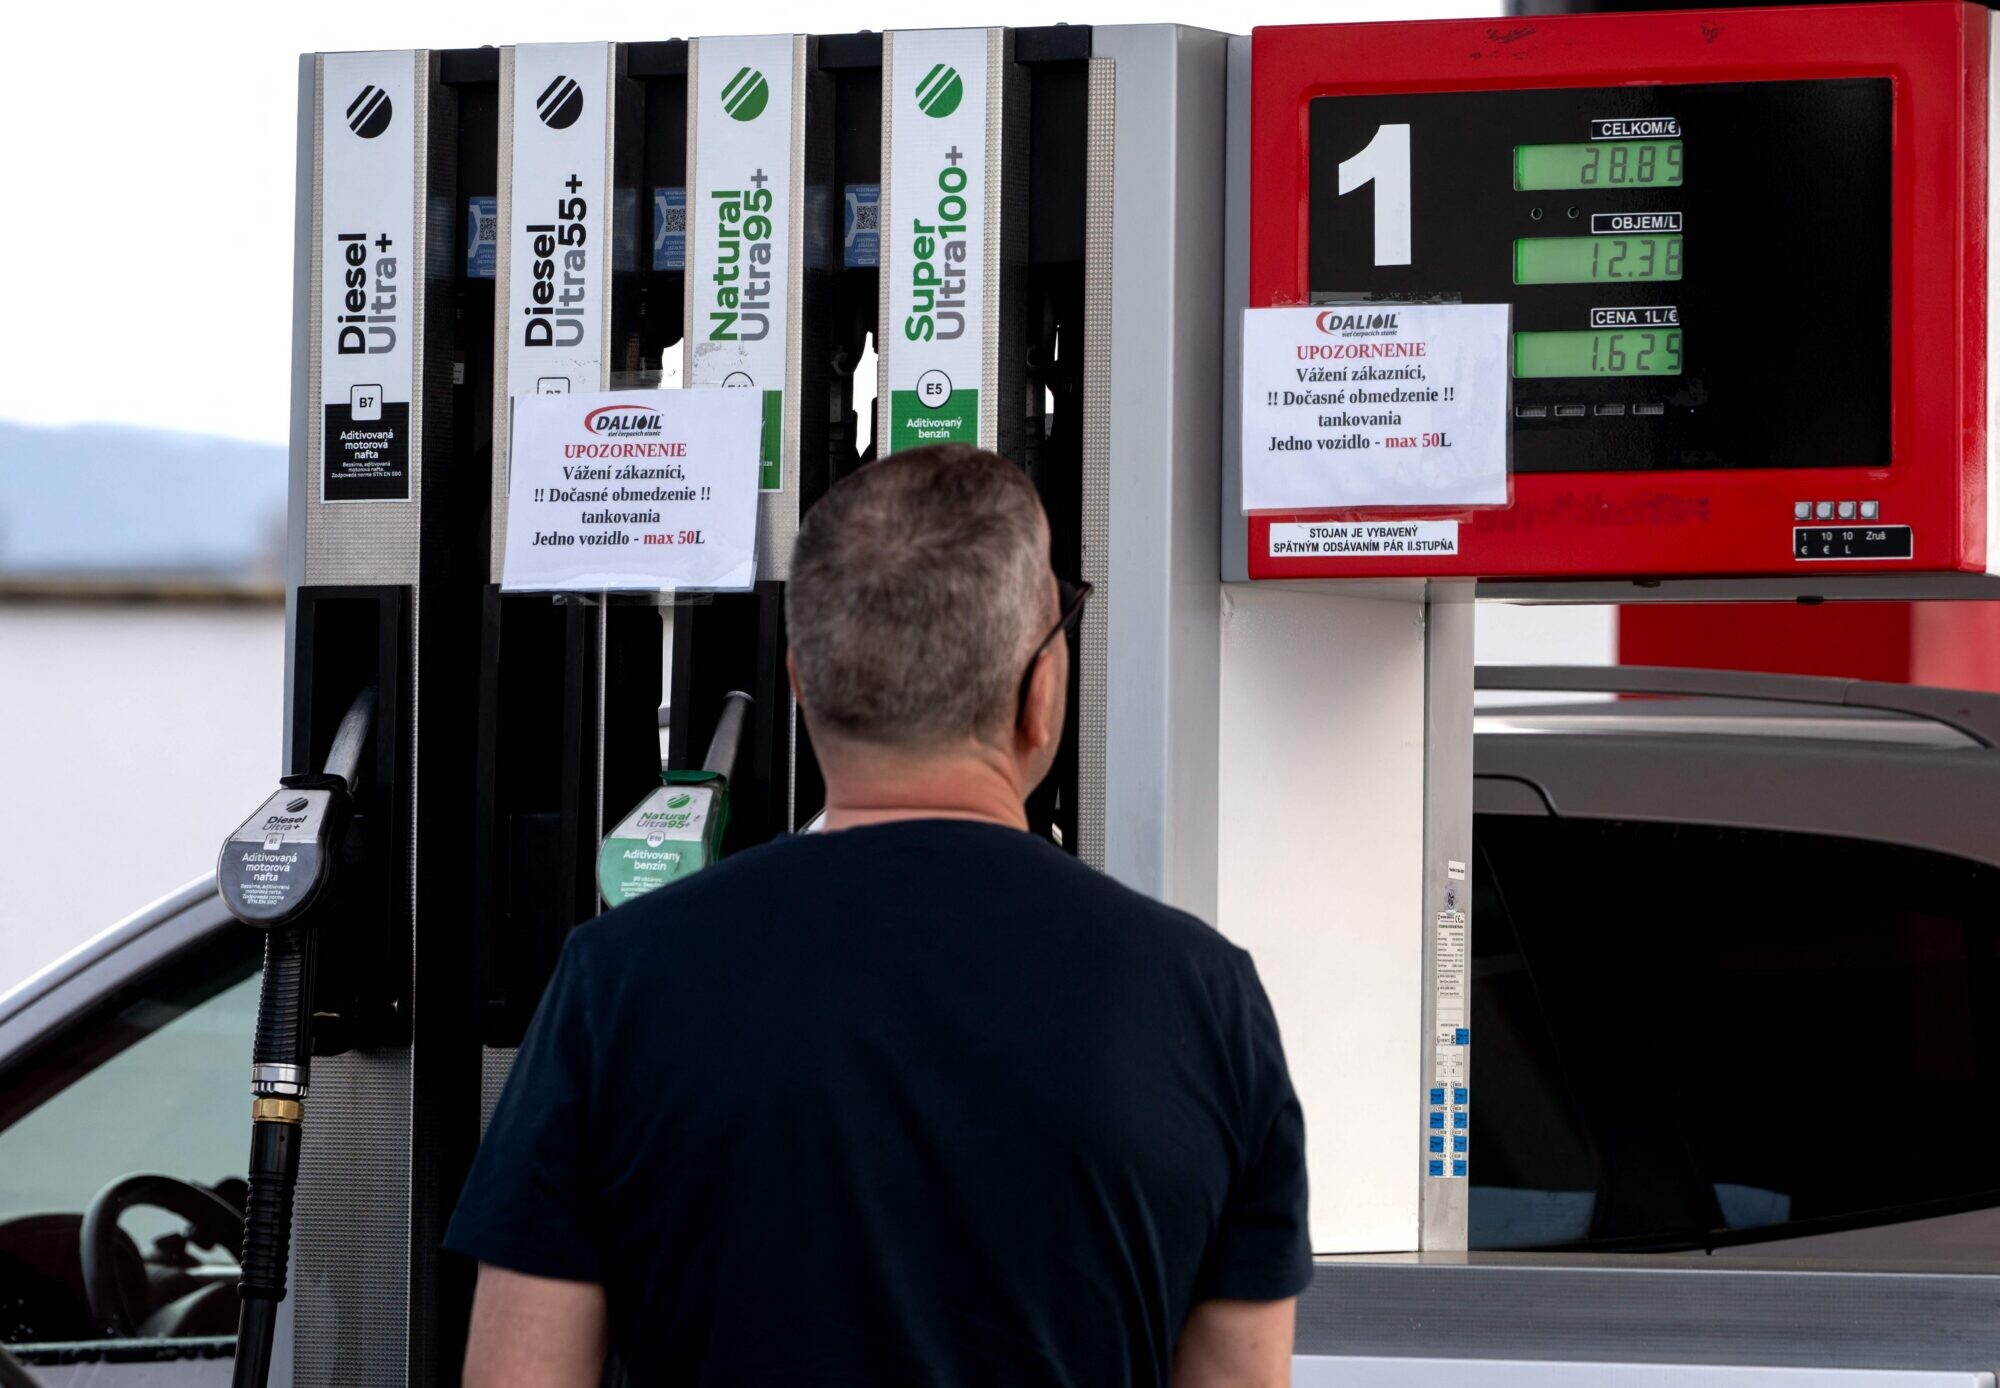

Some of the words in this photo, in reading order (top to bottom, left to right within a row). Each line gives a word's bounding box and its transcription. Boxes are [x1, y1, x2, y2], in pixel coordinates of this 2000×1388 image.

[1602, 121, 1677, 136] CELKOM/€
[1339, 123, 1411, 266] 1
[1611, 216, 1678, 230] OBJEM/L
[936, 145, 967, 340] Ultra100+
[555, 174, 587, 347] Ultra55+
[740, 168, 773, 341] Ultra95+
[709, 190, 741, 341] Natural
[525, 225, 556, 347] Diesel
[905, 218, 942, 342] Super
[338, 233, 366, 354] Diesel
[368, 233, 397, 354] Ultra+
[1596, 311, 1637, 324] CENA
[1296, 342, 1426, 360] UPOZORNENIE
[1296, 366, 1347, 383] Vážení
[1351, 364, 1426, 382] zákazníci,
[926, 383, 942, 395] E5
[359, 397, 374, 408] B7
[1267, 391, 1278, 406] !!
[1282, 389, 1345, 406] Dočasné
[1349, 387, 1438, 404] obmedzenie
[1443, 387, 1455, 401] !!
[906, 416, 962, 429] Aditivovaný
[1318, 411, 1402, 428] tankovania
[340, 429, 394, 440] Aditivovaná
[918, 428, 950, 438] benzín
[345, 439, 388, 449] motorová
[1268, 435, 1312, 452] Jedno
[1316, 434, 1370, 450] vozidlo
[1385, 436, 1417, 448] max
[1422, 432, 1452, 447] 50L
[354, 450, 379, 459] nafta
[564, 443, 687, 459] UPOZORNENIE
[563, 465, 611, 480] Vážení
[615, 464, 685, 481] zákazníci,
[534, 488, 544, 502] !!
[549, 487, 608, 502] Dočasné
[612, 486, 696, 501] obmedzenie
[700, 486, 711, 501] !!
[581, 509, 660, 524] tankovania
[532, 531, 575, 547] Jedno
[579, 530, 629, 545] vozidlo
[643, 533, 674, 545] max
[678, 530, 705, 545] 50L
[1309, 528, 1348, 539] STOJAN
[1351, 527, 1362, 538] JE
[1367, 525, 1418, 538] VYBAVENÝ
[1802, 532, 1807, 541] 1
[1822, 531, 1832, 540] 10
[1842, 531, 1853, 540] 10
[1866, 531, 1886, 540] Zruš
[1273, 540, 1319, 553] SPÄTNÝM
[1323, 539, 1380, 552] ODSÁVANÍM
[1383, 538, 1404, 551] PÁR
[1407, 538, 1454, 551] II.STUPŇA
[1845, 545, 1851, 554] L
[267, 815, 307, 824] Diesel
[641, 812, 691, 820] Natural
[262, 823, 300, 831] Ultra+
[636, 820, 691, 829] Ultra95+
[242, 852, 297, 863] Aditivovaná
[246, 863, 290, 872] motorová
[634, 860, 667, 870] benzín
[253, 872, 278, 881] nafta
